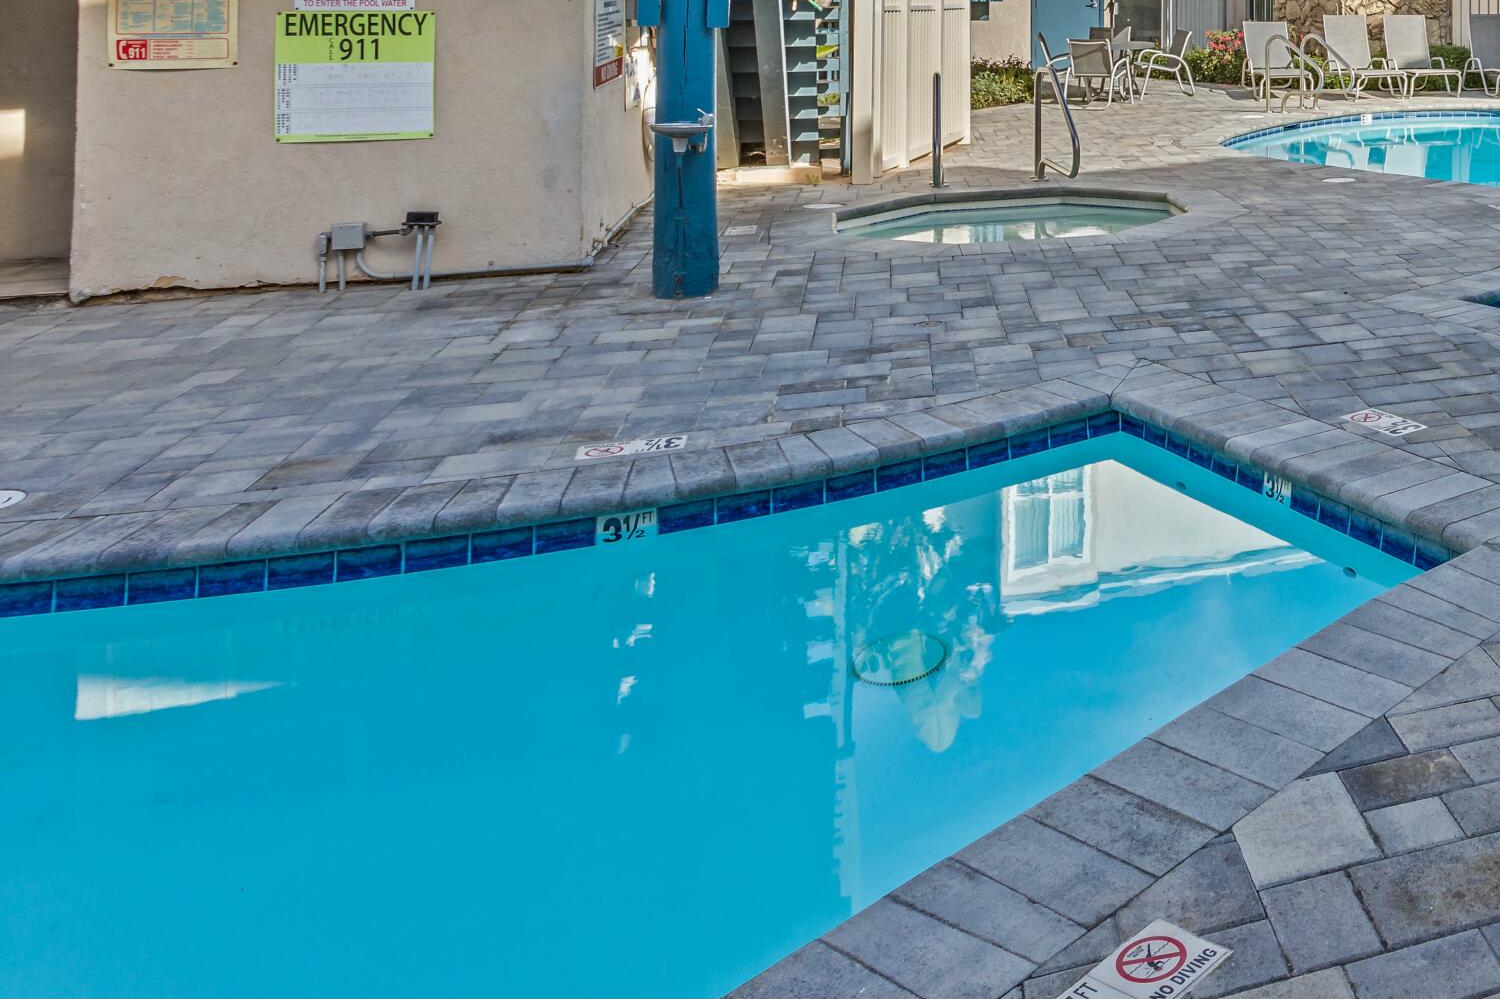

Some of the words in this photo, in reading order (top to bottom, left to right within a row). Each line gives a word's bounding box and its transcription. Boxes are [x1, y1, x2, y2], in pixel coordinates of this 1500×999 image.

[285, 13, 428, 36] EMERGENCY
[128, 47, 146, 58] 911
[339, 38, 379, 60] 911
[643, 511, 653, 524] FT
[1170, 947, 1218, 986] DIVING
[1073, 982, 1098, 999] FT
